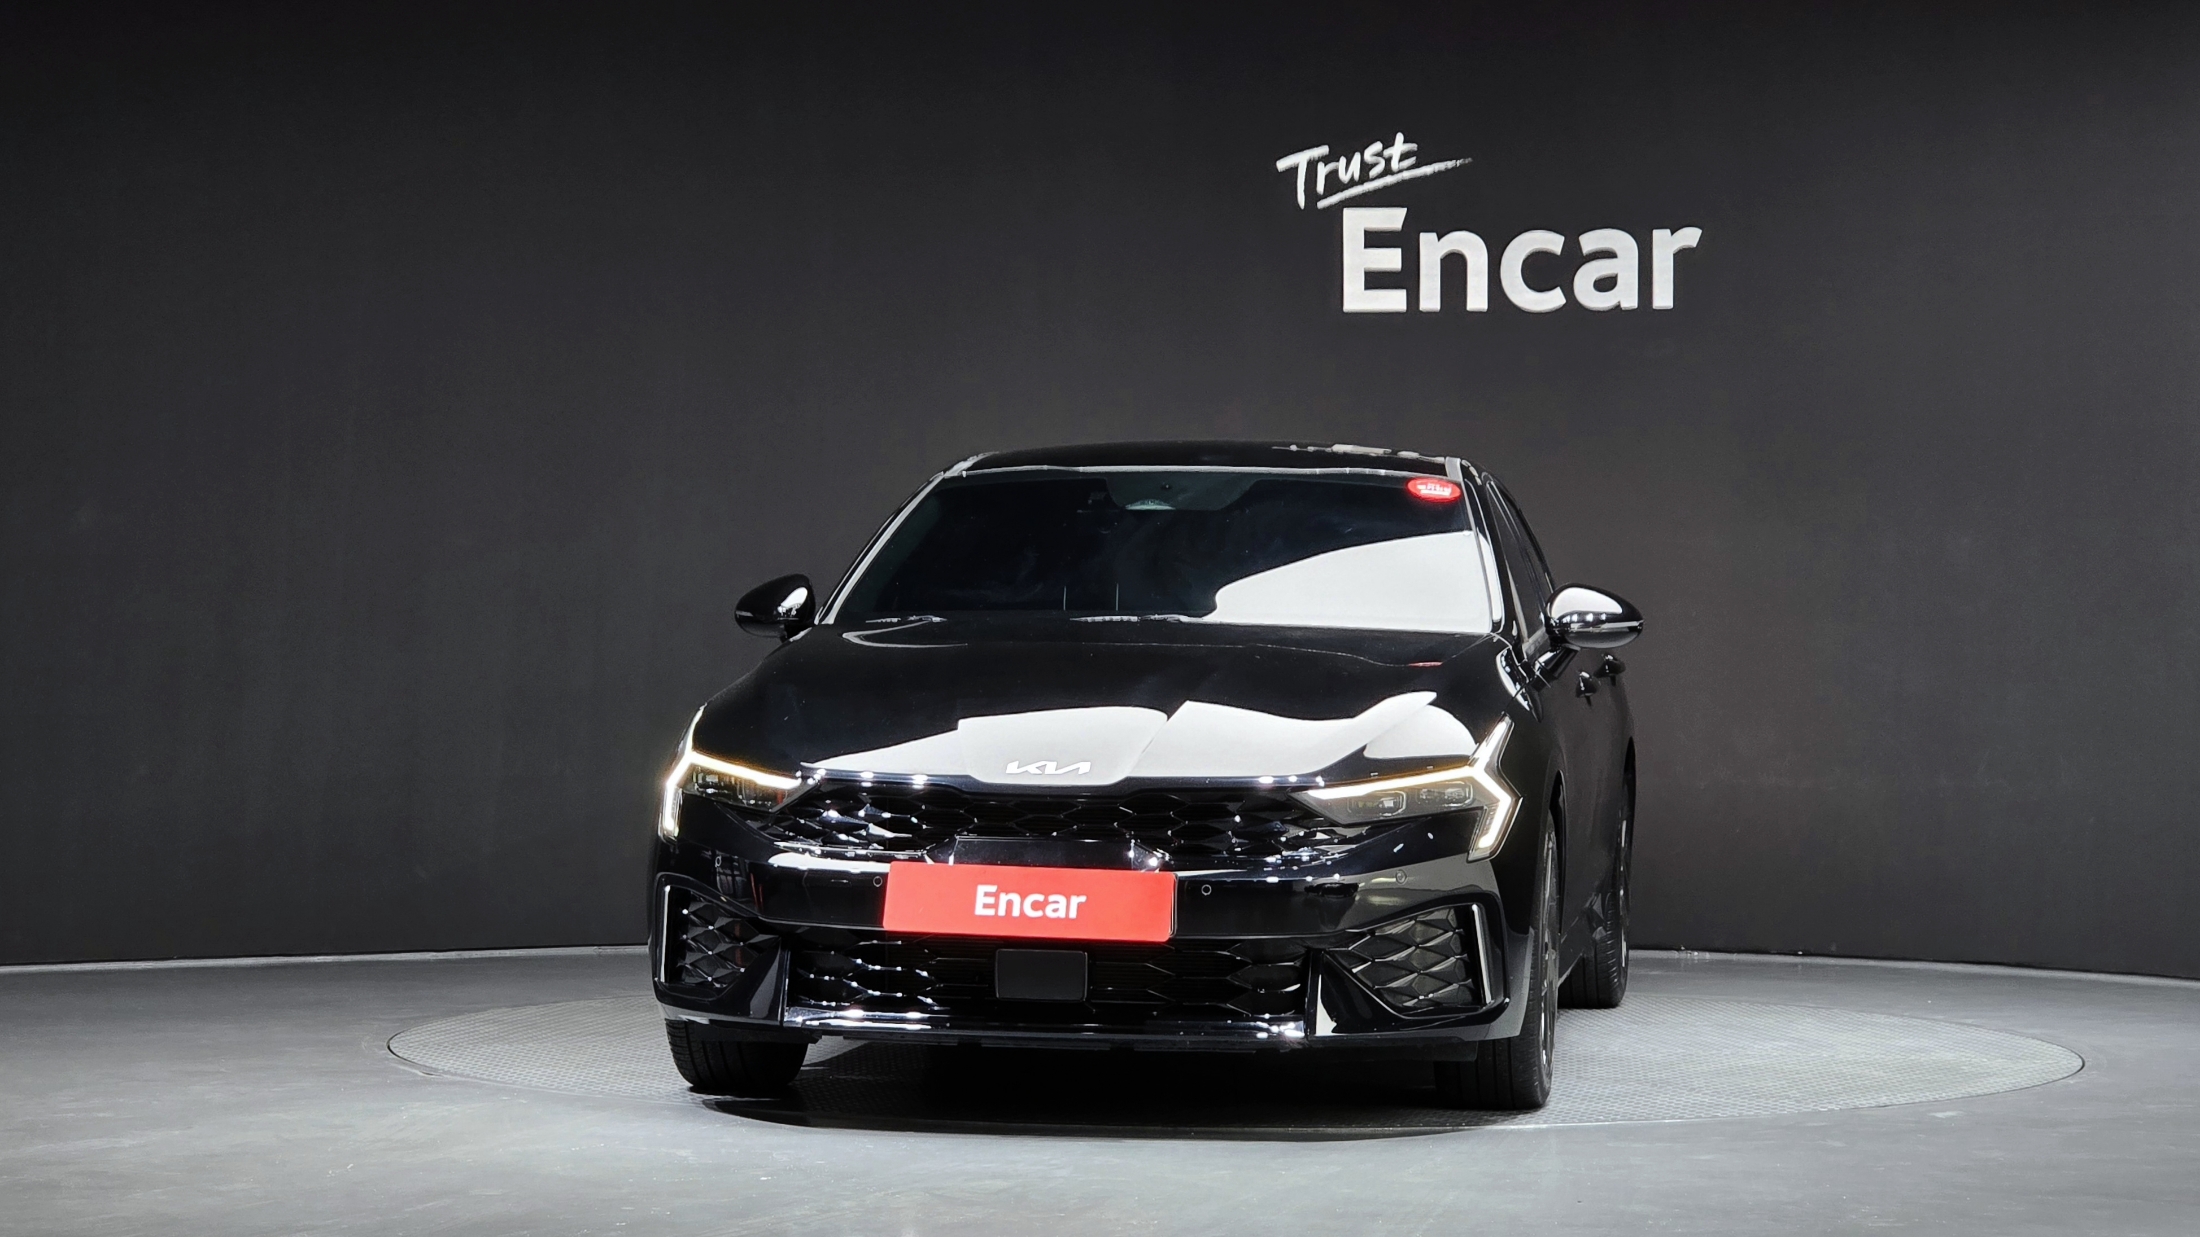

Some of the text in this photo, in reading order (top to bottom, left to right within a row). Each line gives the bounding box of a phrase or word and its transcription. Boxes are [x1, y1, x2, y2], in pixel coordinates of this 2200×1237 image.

[1276, 132, 1418, 209] Trust
[1342, 207, 1702, 313] Encar
[974, 885, 1087, 919] Encar
